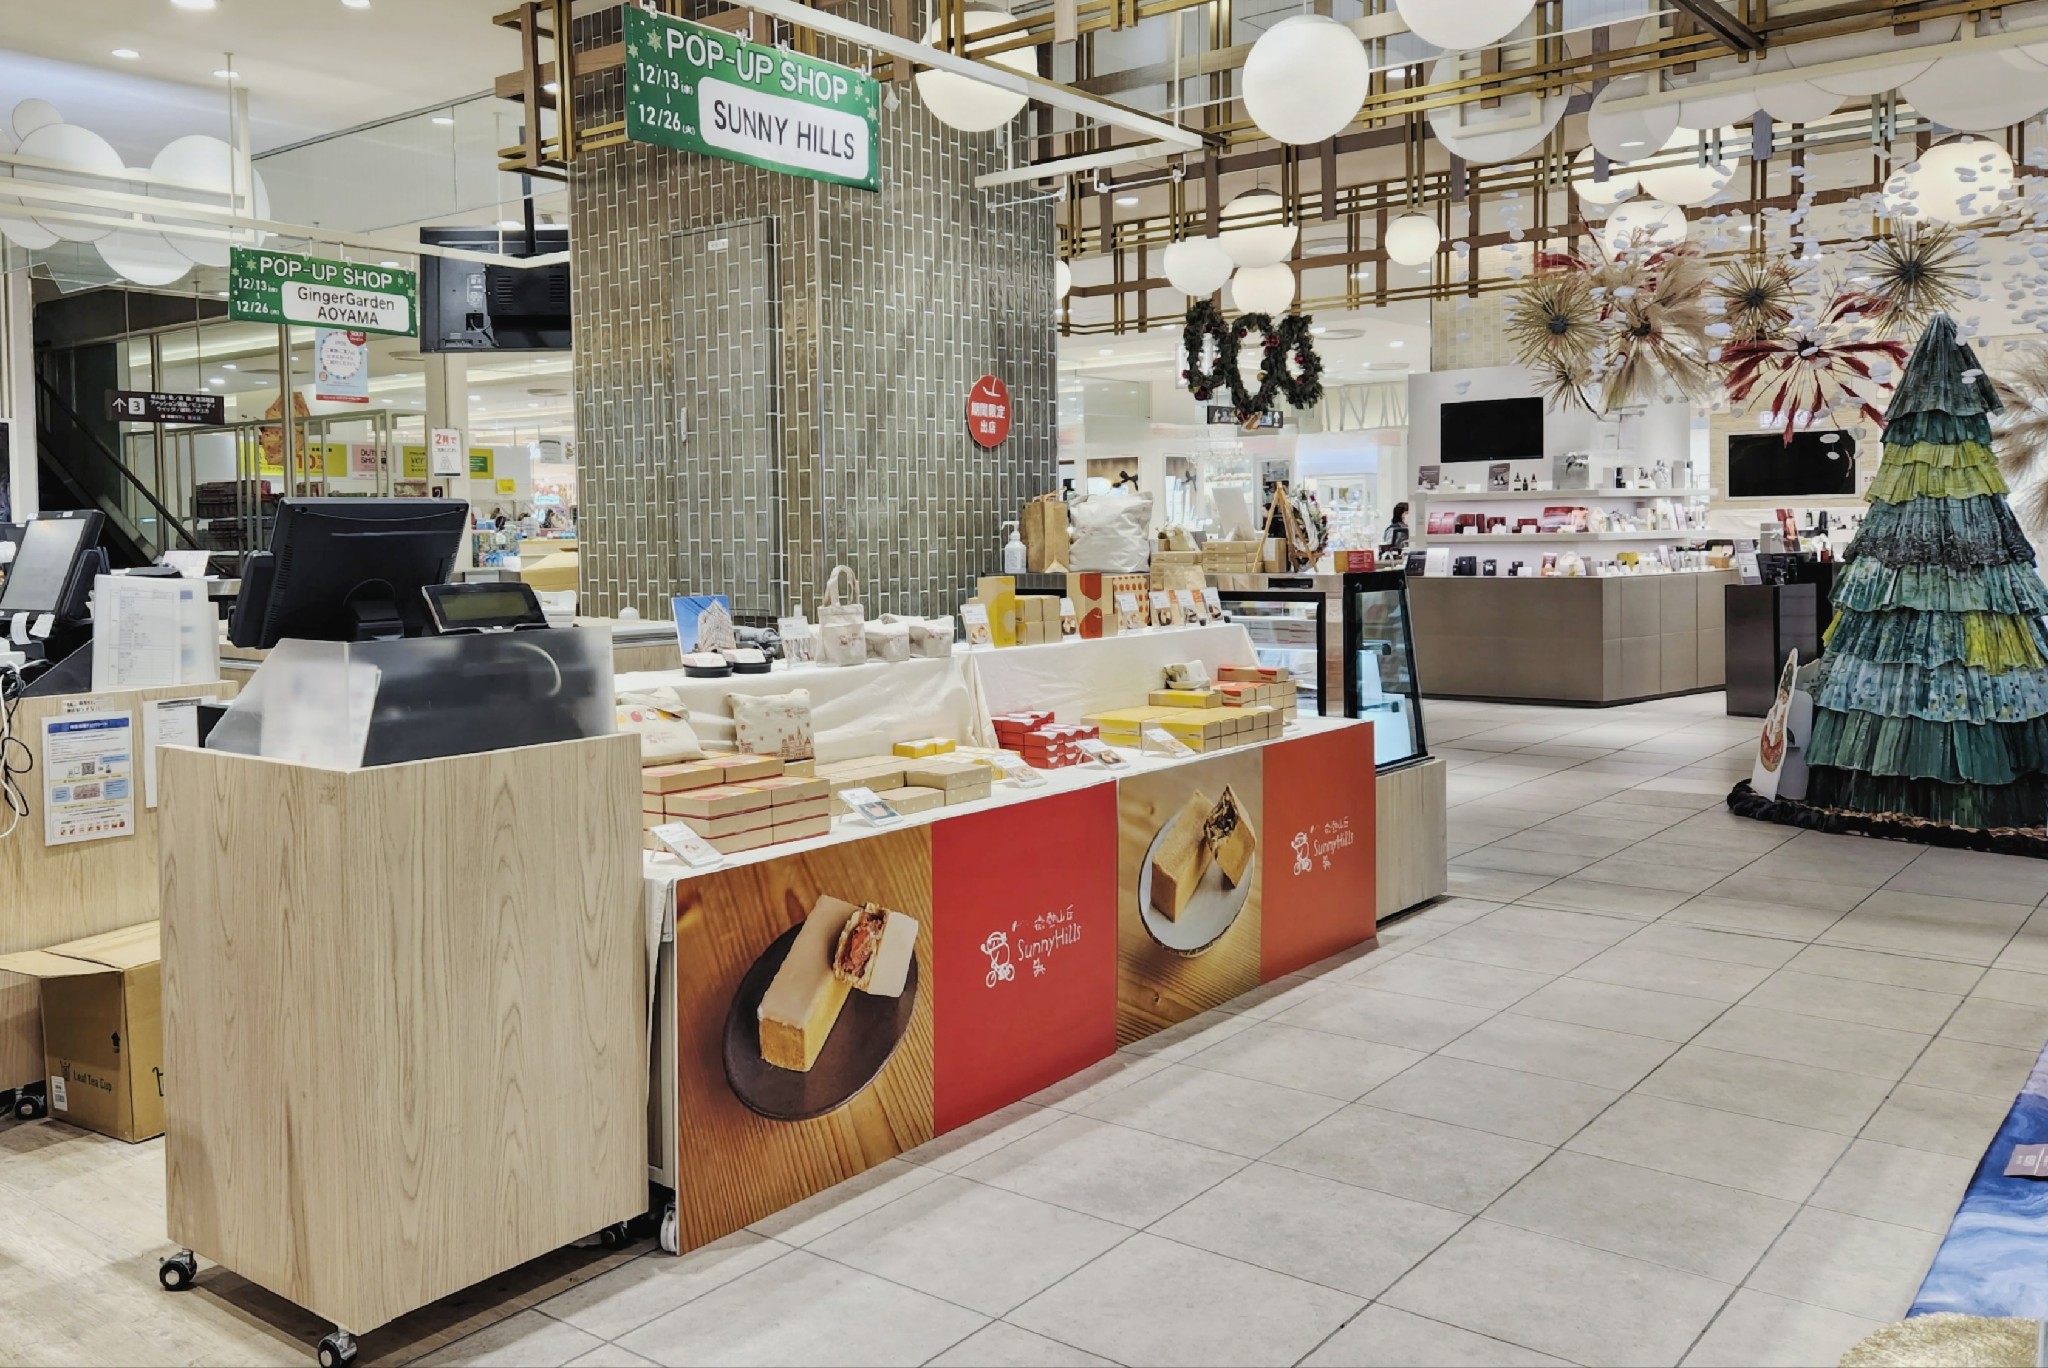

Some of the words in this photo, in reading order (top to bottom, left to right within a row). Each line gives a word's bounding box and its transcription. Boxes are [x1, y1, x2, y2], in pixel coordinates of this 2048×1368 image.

[666, 27, 774, 84] POP-UP
[780, 60, 848, 103] SHOP
[714, 100, 788, 146] SUNNY
[797, 120, 855, 160] HILLS
[260, 256, 338, 282] POP-UP
[343, 267, 393, 288] SHOP
[297, 286, 395, 311] GingerGarden
[317, 306, 379, 326] AOYAMA
[133, 400, 141, 411] 3
[971, 401, 1006, 419] 期間限定
[980, 419, 996, 435] 出店
[1314, 830, 1354, 857] SunnyHills
[1018, 923, 1082, 961] SunnyHills
[87, 1074, 98, 1088] Tea
[99, 1078, 112, 1095] Cup
